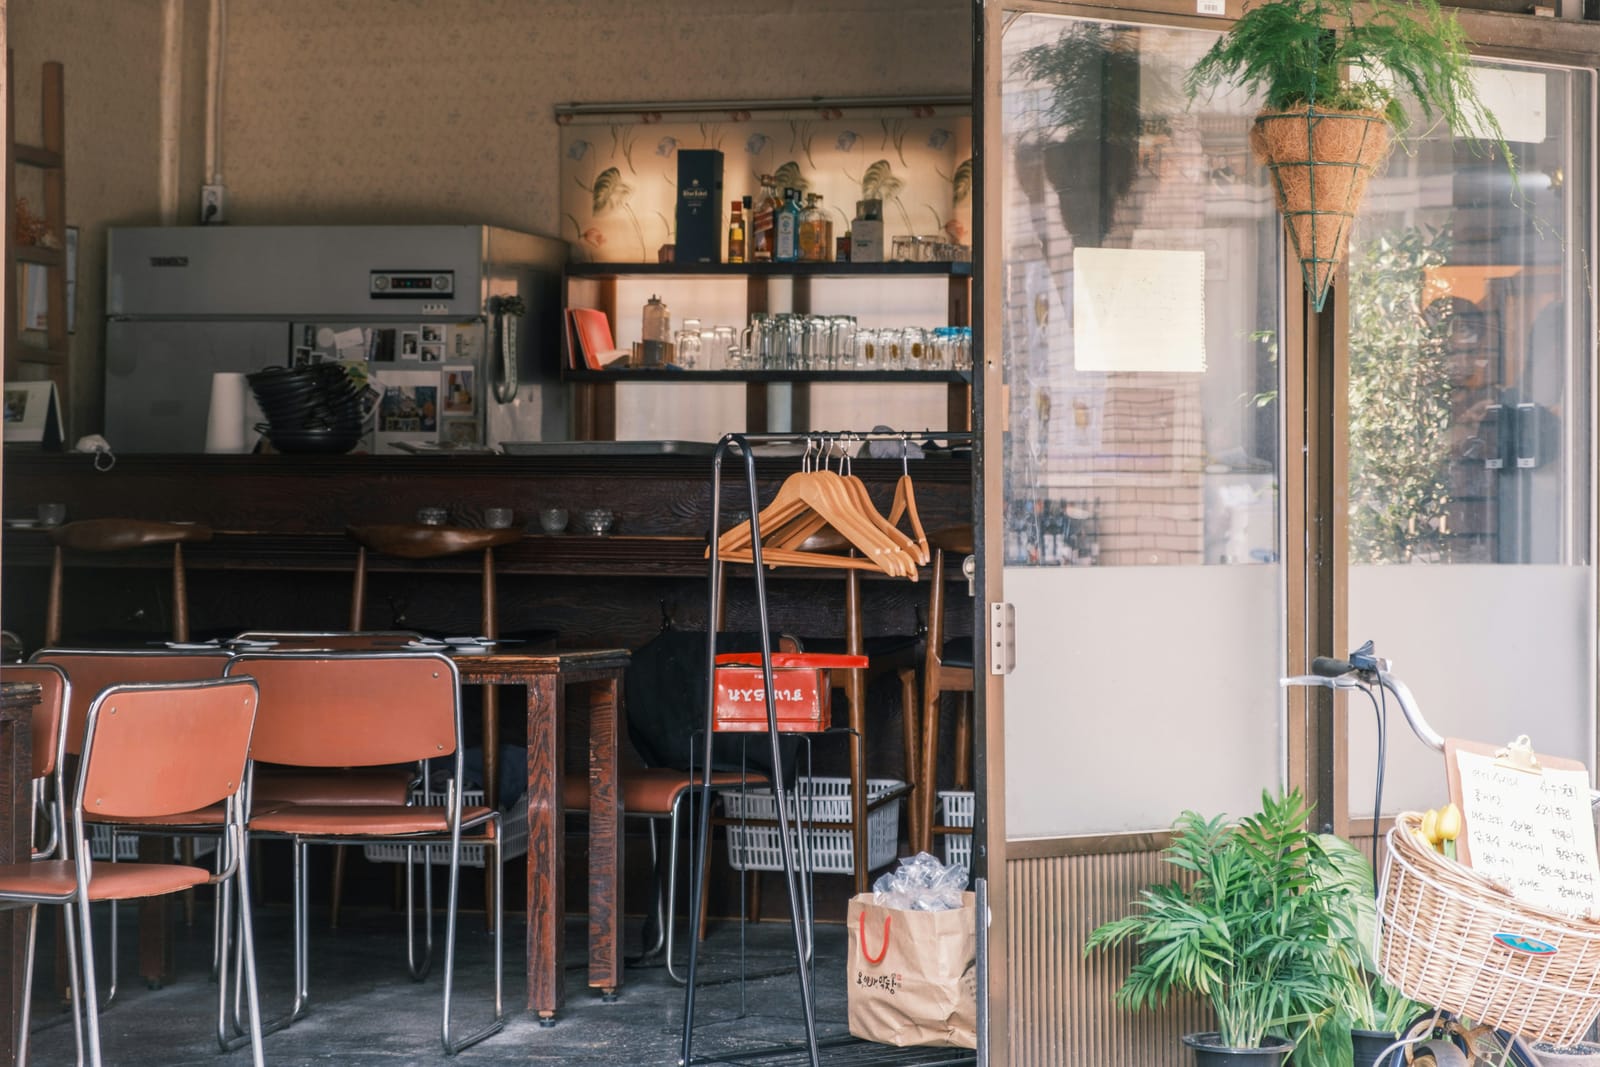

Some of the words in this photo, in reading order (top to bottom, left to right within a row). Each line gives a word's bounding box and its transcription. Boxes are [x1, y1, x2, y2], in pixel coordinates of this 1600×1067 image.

[727, 688, 804, 702] すいら入れ
